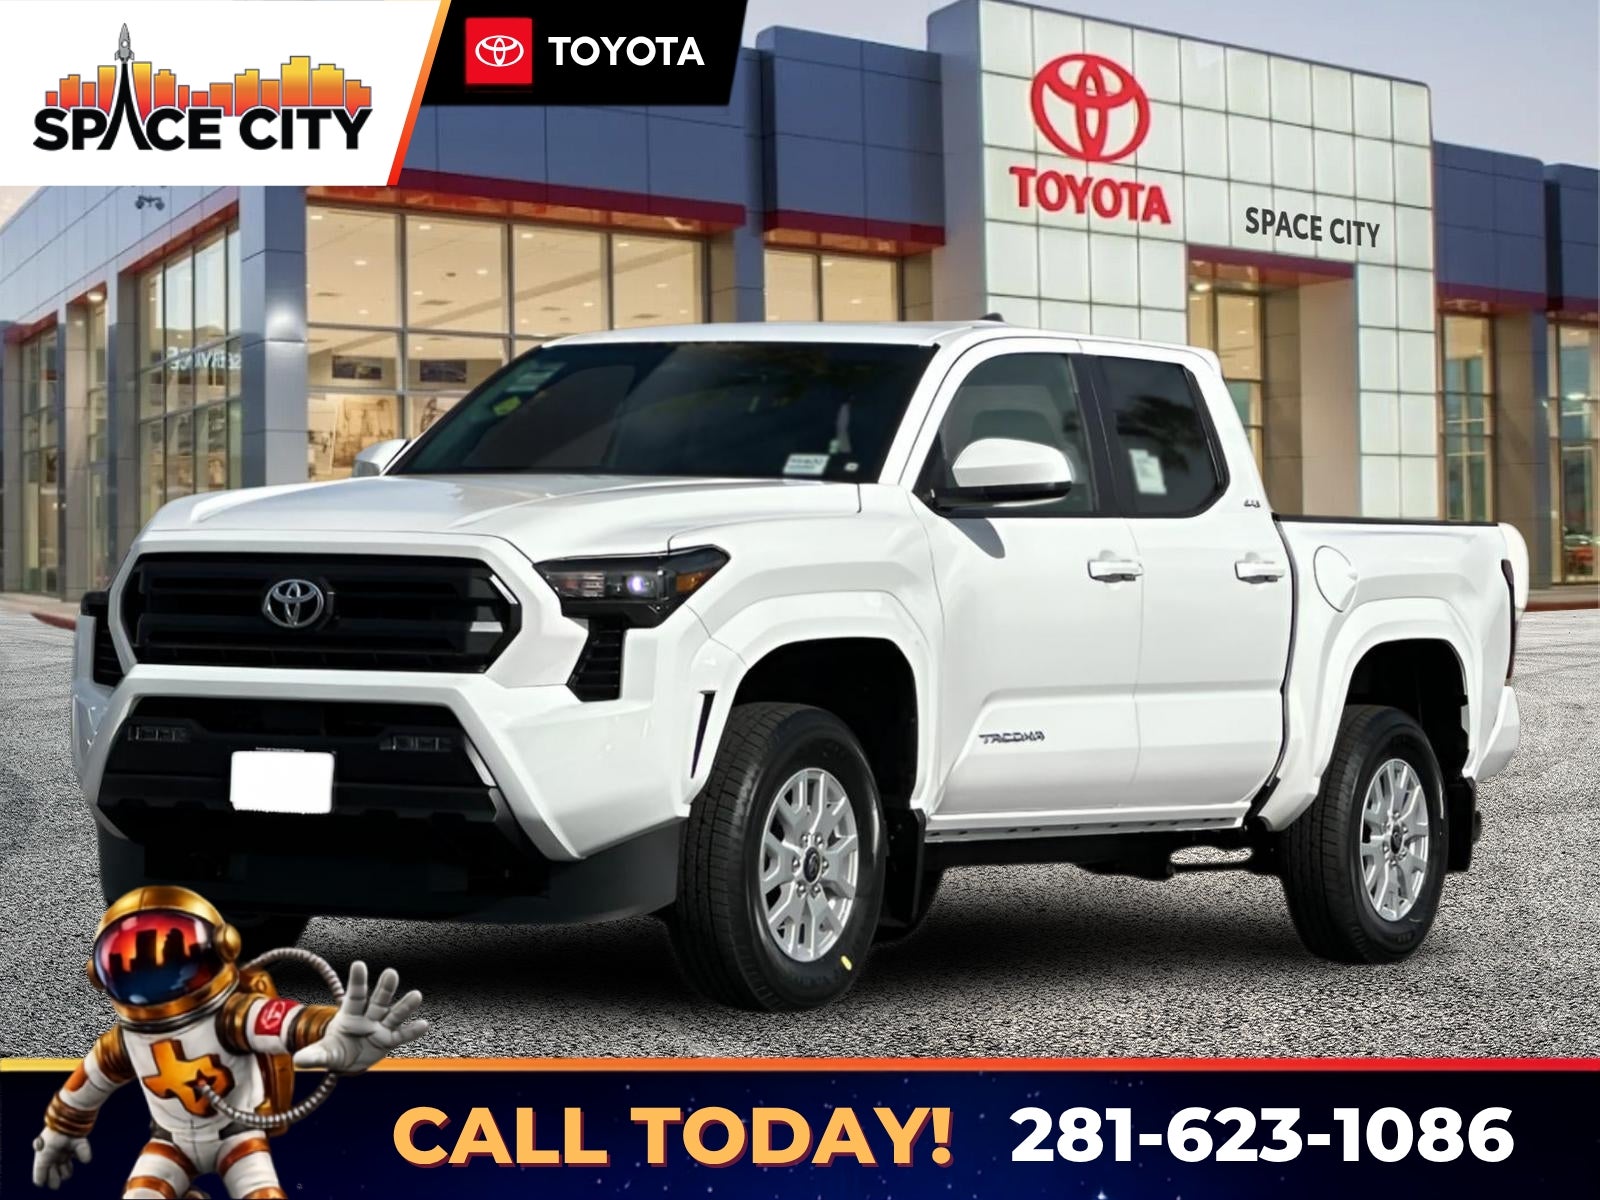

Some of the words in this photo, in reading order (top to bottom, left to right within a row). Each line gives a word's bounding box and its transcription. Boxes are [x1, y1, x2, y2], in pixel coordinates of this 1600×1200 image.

[1009, 166, 1171, 224] TOYOTA
[1245, 206, 1323, 242] SPACE
[1329, 217, 1380, 248] CITY
